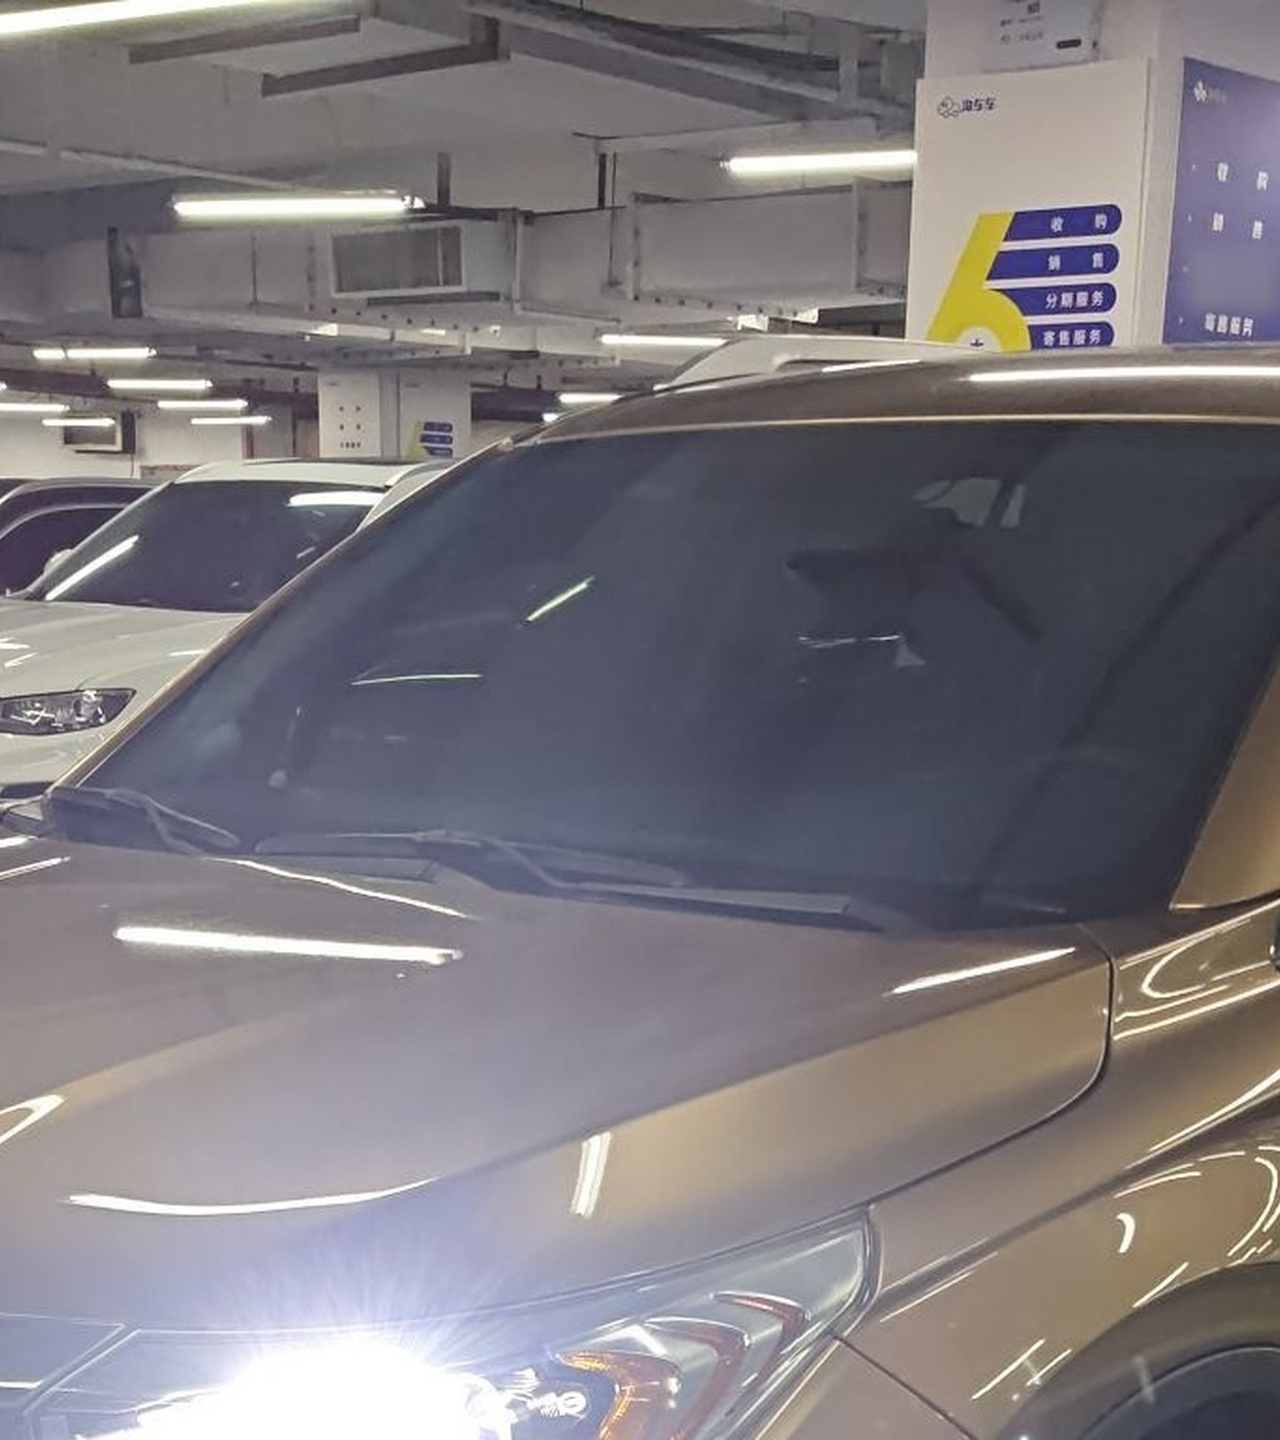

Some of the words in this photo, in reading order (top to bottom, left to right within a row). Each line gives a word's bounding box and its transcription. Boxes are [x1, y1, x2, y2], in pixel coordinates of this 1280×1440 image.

[1045, 290, 1104, 309] 分期服务
[1043, 329, 1101, 347] 寄售服务
